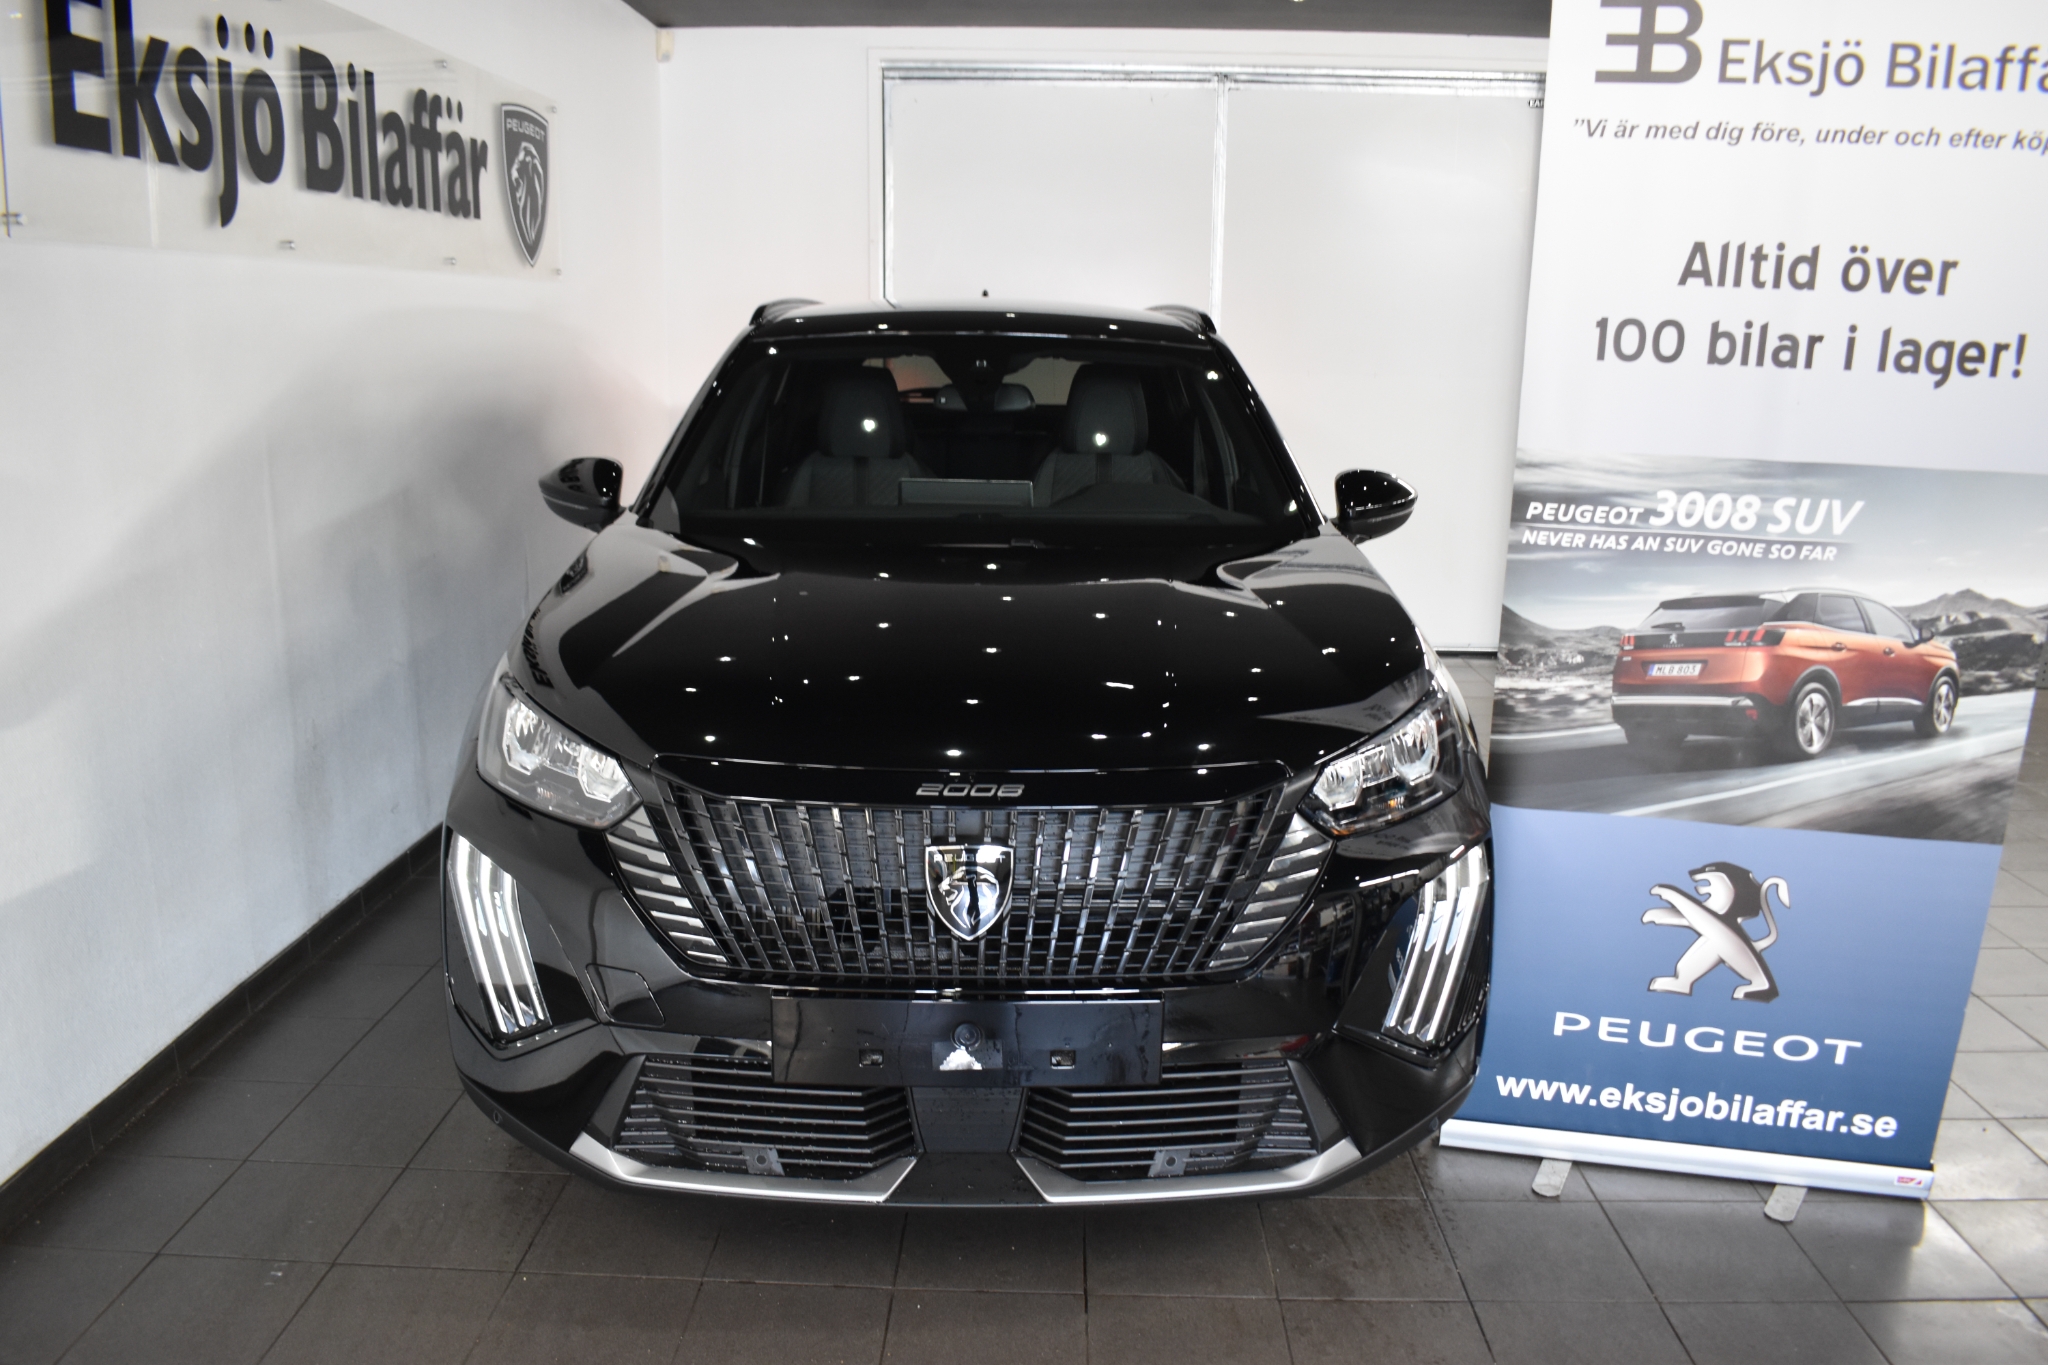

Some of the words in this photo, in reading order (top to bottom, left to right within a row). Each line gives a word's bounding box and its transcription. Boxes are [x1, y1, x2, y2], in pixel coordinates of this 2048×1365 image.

[1717, 39, 1866, 97] Eksjö
[45, 0, 285, 228] Eksjö
[299, 45, 488, 221] Bilaffär
[506, 117, 546, 143] PEUGEOT
[1613, 119, 1640, 139] är
[1645, 120, 1700, 140] med
[1705, 121, 1744, 146] dig
[1751, 122, 1806, 147] före,
[1815, 124, 1889, 145] under
[1894, 127, 1941, 147] och
[1948, 127, 2006, 149] efter
[1677, 241, 1821, 291] Alltid
[1840, 245, 1959, 296] över
[1596, 317, 1686, 364] 100
[1706, 320, 1825, 370] bilar
[1843, 324, 1858, 370] i
[1877, 326, 2028, 389] lager!
[1526, 501, 1645, 525] PEUGEOT
[1649, 489, 1762, 532] 3008
[1765, 496, 1866, 536] SUV
[1522, 529, 1587, 549] NEVER
[1589, 533, 1629, 551] HAS
[1630, 535, 1661, 551] AN
[1663, 536, 1705, 554] SUV
[1706, 539, 1766, 559] GONE
[1768, 543, 1797, 560] SO
[1799, 544, 1838, 561] FAR
[916, 783, 1025, 797] 2008
[1553, 1011, 1863, 1066] PEUGEOT
[1495, 1074, 1898, 1139] www.eksjobilaffar.se
